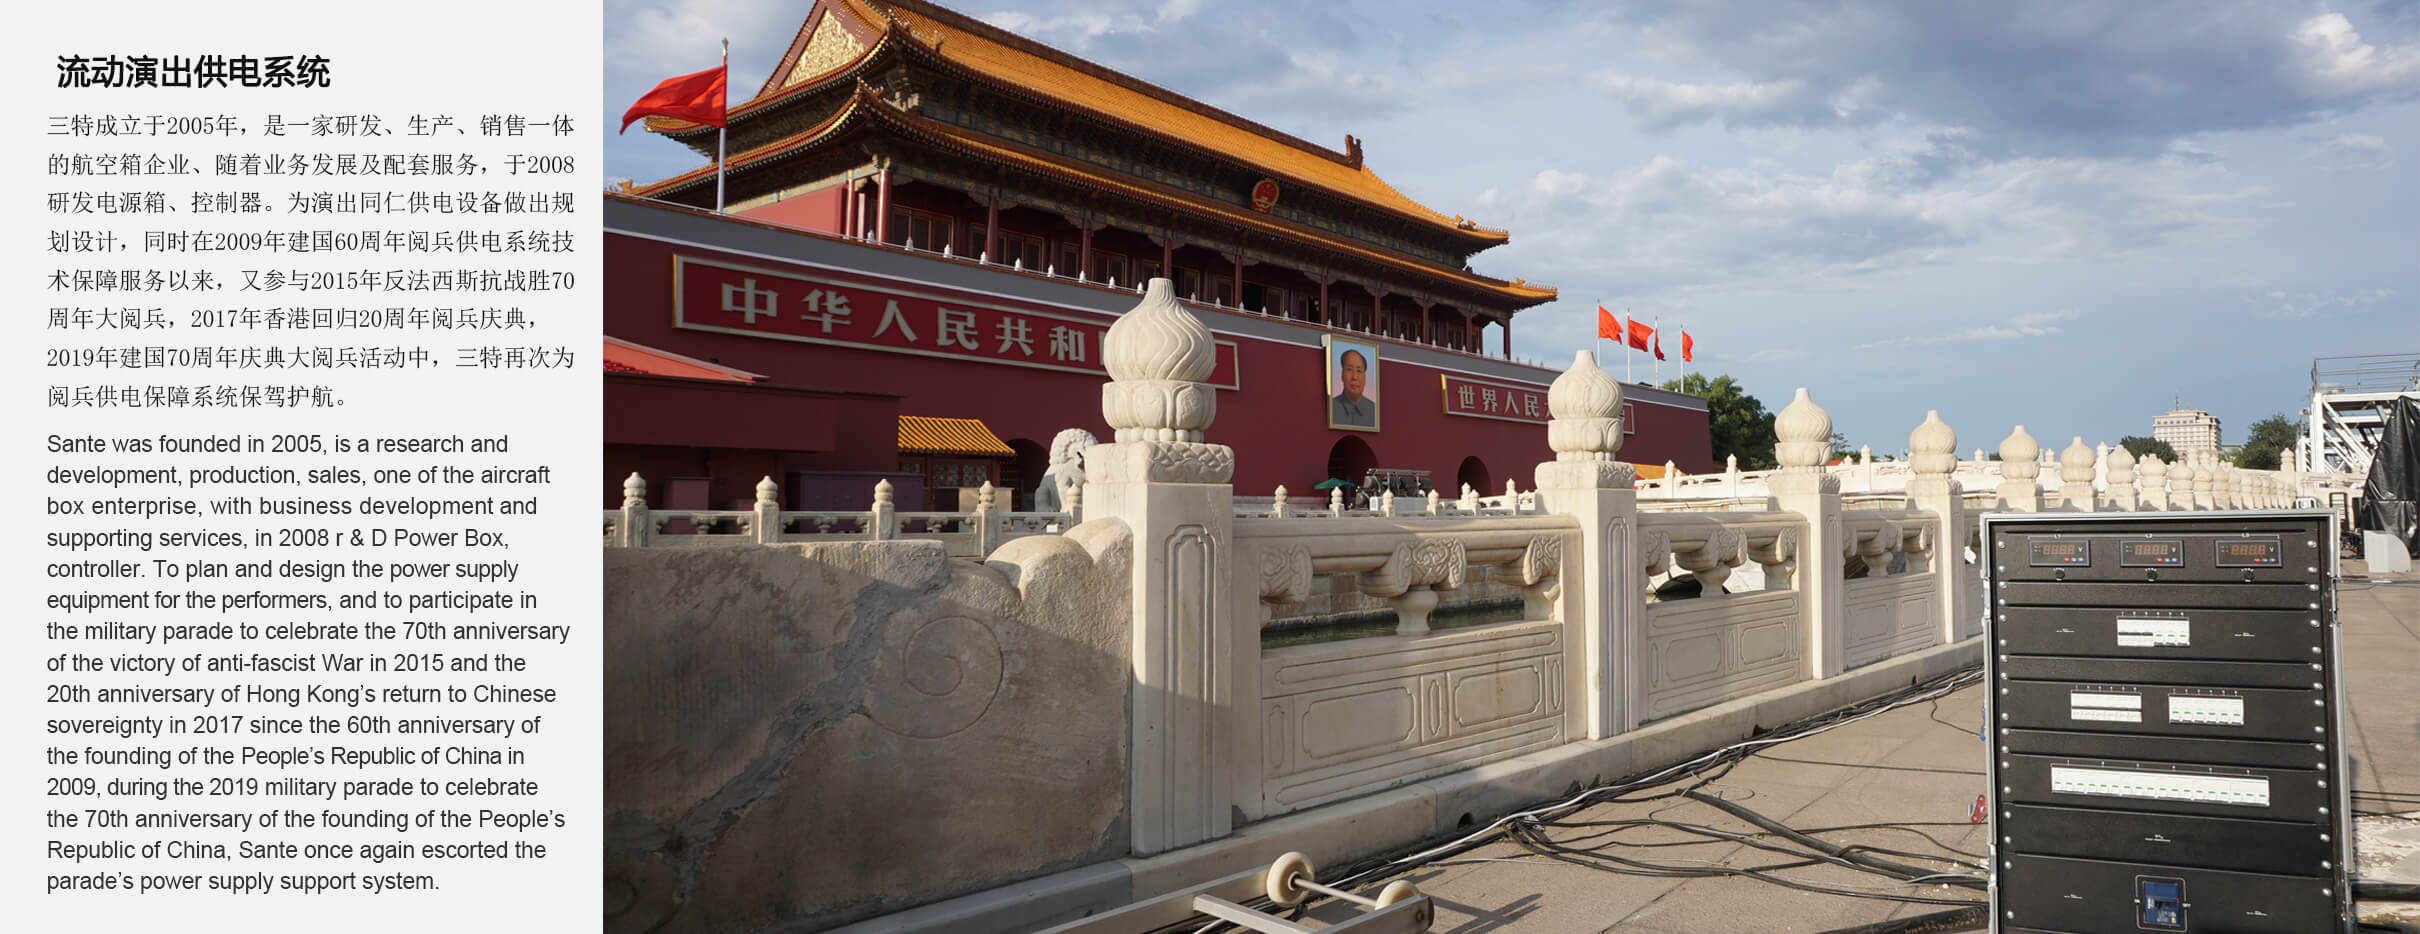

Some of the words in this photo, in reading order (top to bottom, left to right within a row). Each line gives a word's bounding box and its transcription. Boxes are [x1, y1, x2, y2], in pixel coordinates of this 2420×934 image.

[720, 277, 1113, 369] 中华人民共和
